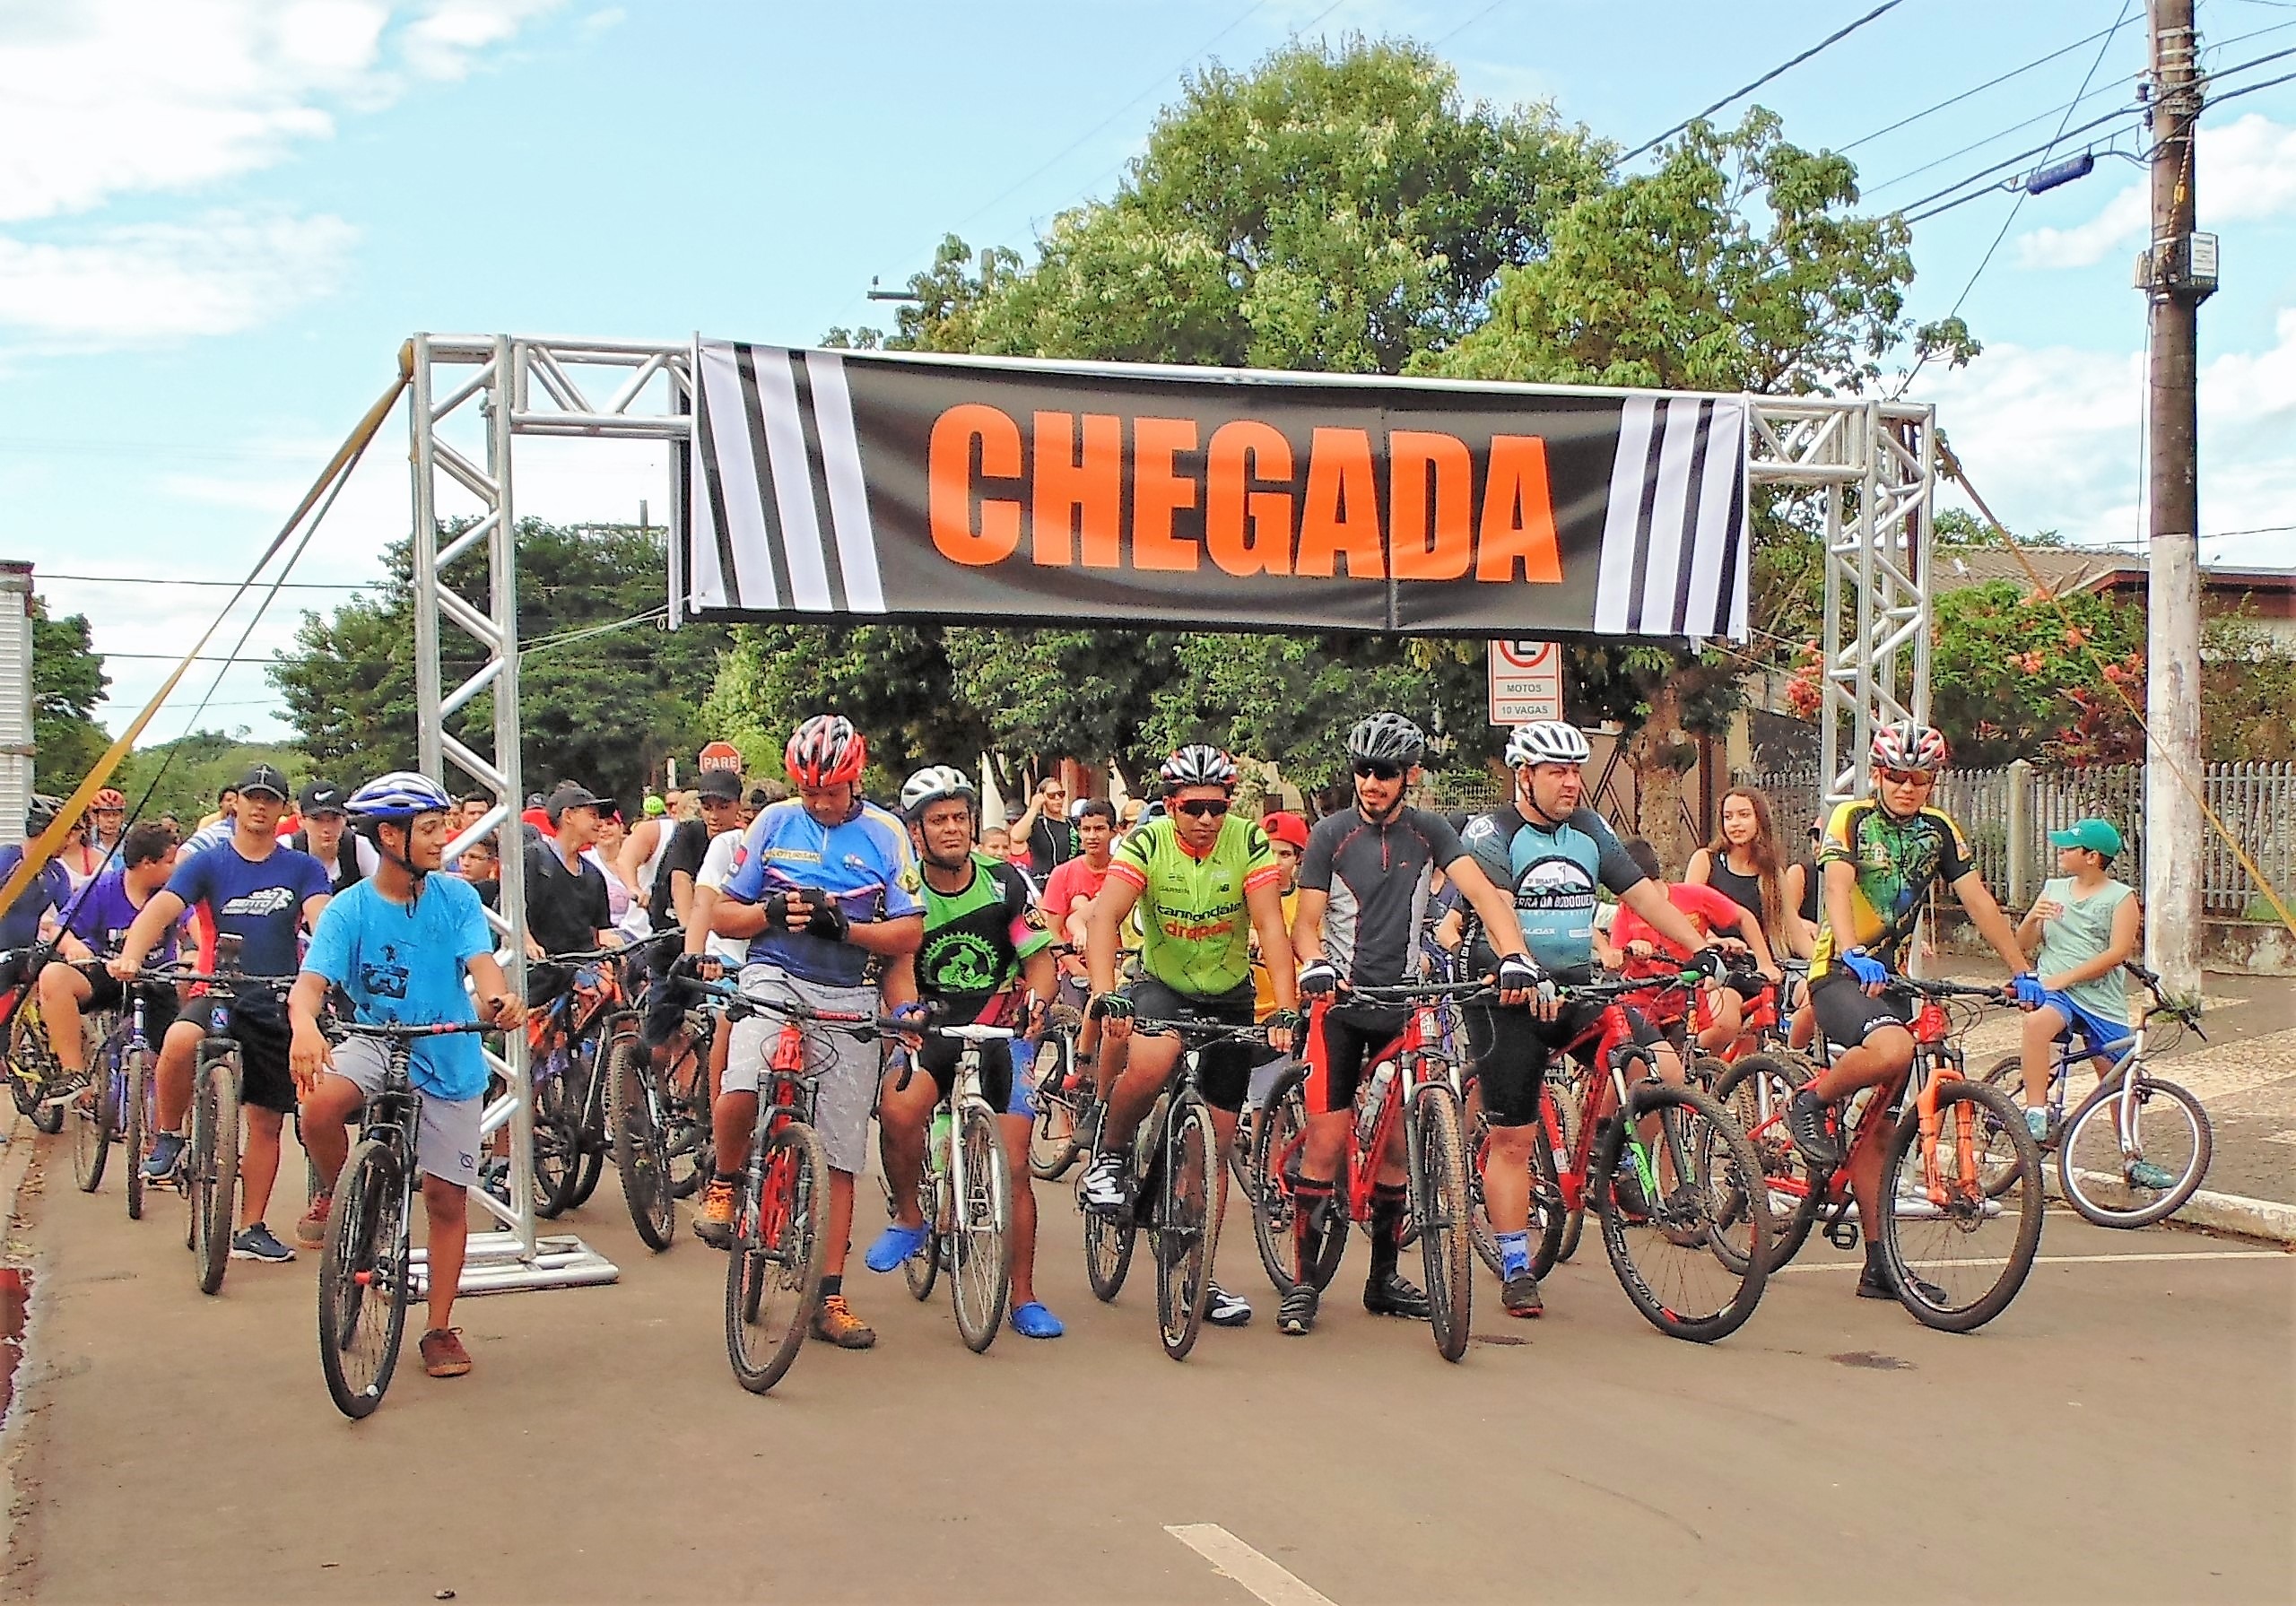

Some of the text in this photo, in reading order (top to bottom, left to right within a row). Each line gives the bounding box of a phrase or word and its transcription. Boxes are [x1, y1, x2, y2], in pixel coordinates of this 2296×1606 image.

[929, 404, 1564, 584] CHEGADA
[1507, 684, 1542, 692] MOTOS
[1502, 706, 1548, 715] 10 VAGAS
[703, 756, 737, 769] PARE
[1540, 896, 1553, 907] DA
[1157, 902, 1241, 922] cannondale
